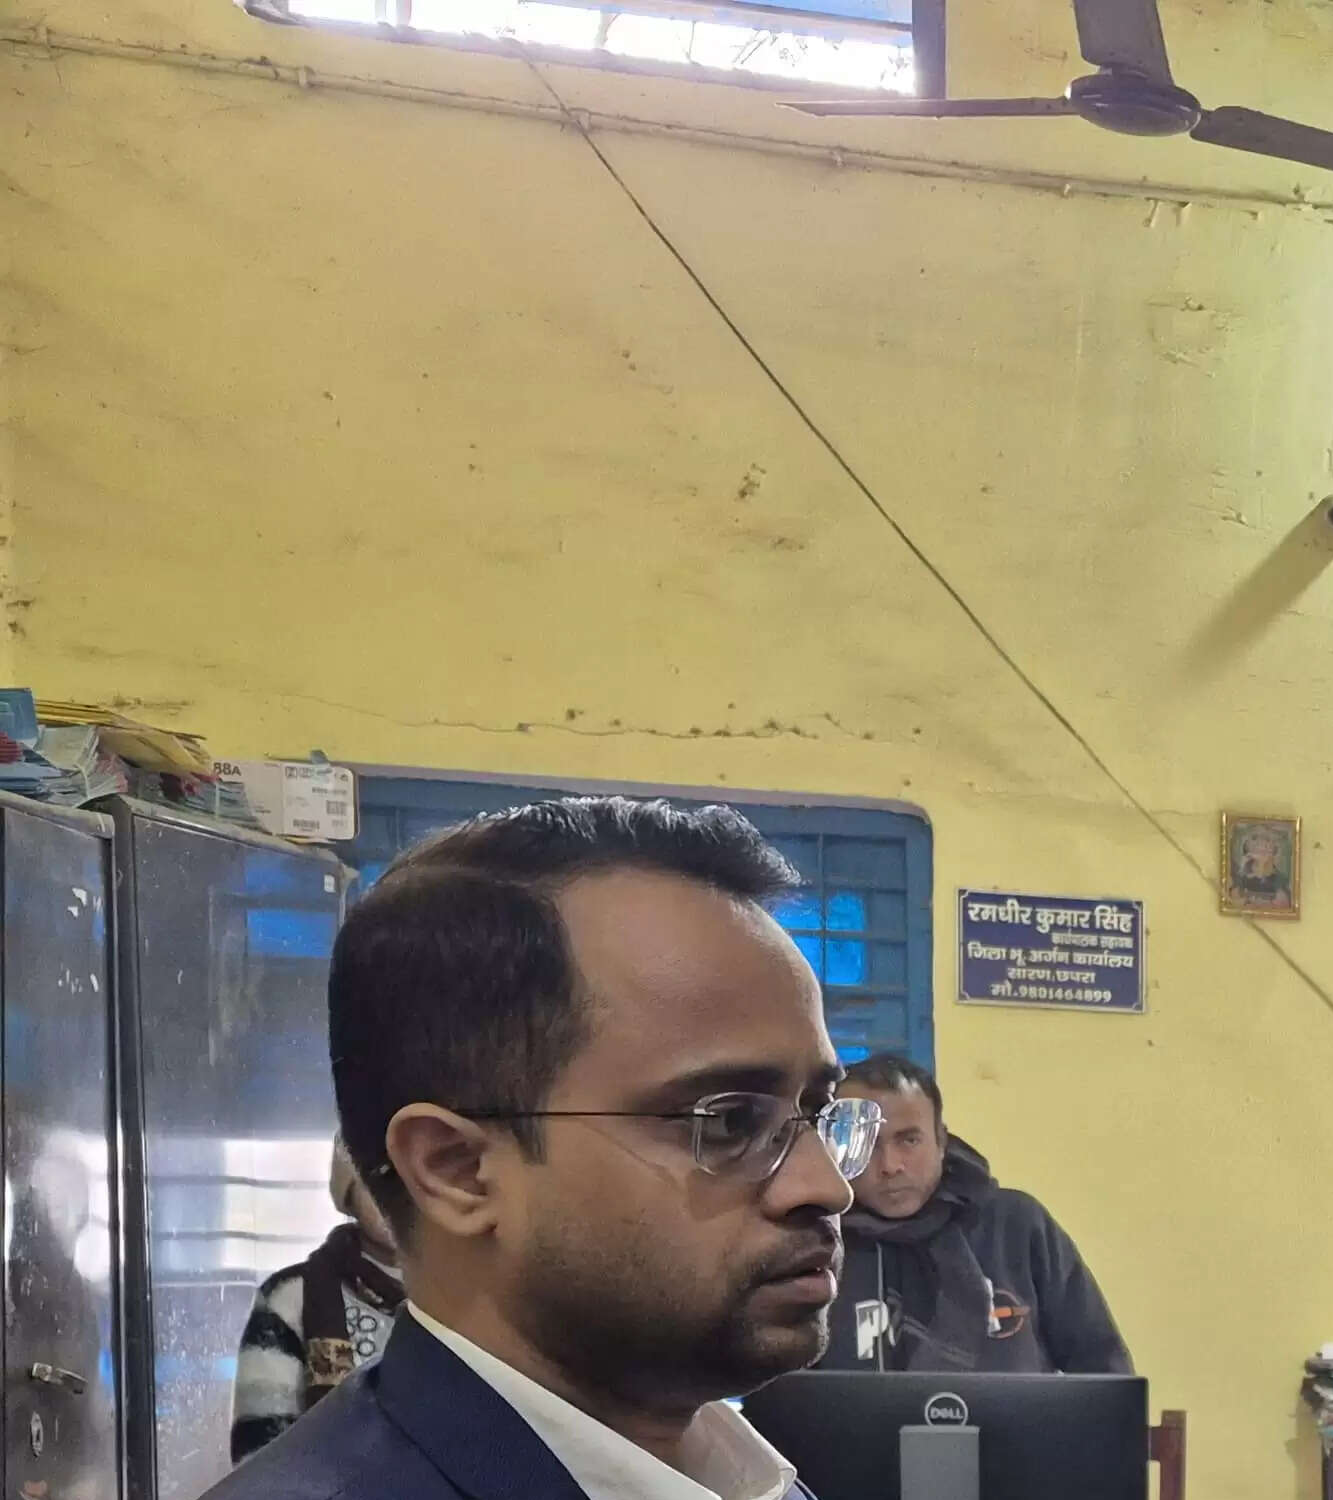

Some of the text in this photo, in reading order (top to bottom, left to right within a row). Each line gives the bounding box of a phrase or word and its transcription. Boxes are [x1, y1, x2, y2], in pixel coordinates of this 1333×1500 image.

[967, 898, 1133, 933] रमधीर कुमार सिंह
[967, 941, 1006, 960] जिला
[1072, 949, 1134, 968] कार्यालय
[930, 1406, 964, 1420] DELL
